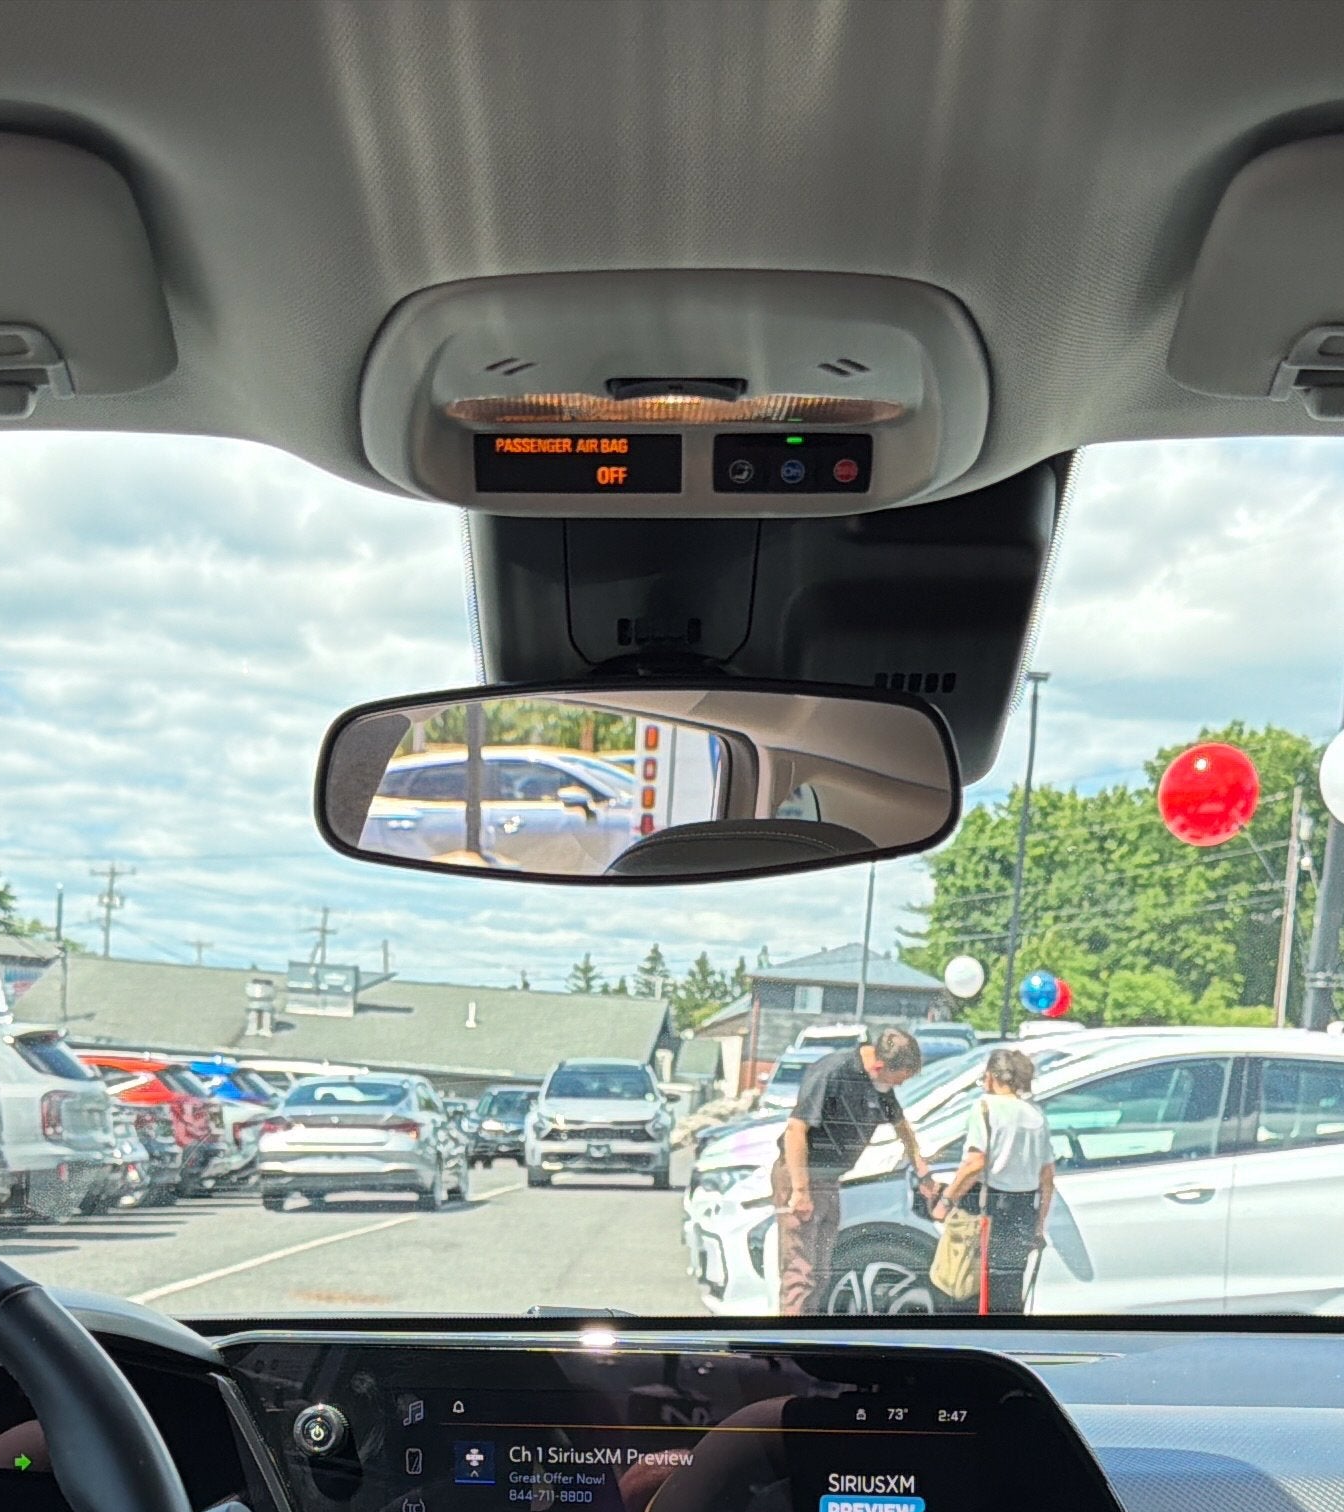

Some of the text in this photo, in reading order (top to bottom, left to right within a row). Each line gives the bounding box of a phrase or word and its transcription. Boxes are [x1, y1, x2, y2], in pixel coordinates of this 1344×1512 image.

[494, 437, 629, 455] PASSENGER AIR BAG
[596, 466, 629, 486] OFF
[937, 1409, 968, 1422] 2:47
[509, 1446, 694, 1467] Ch 1 SiriusXM Preview
[509, 1472, 606, 1486] Great Offer Now!
[827, 1473, 916, 1494] SIRIUSXM
[509, 1489, 593, 1504] 844-711-8800
